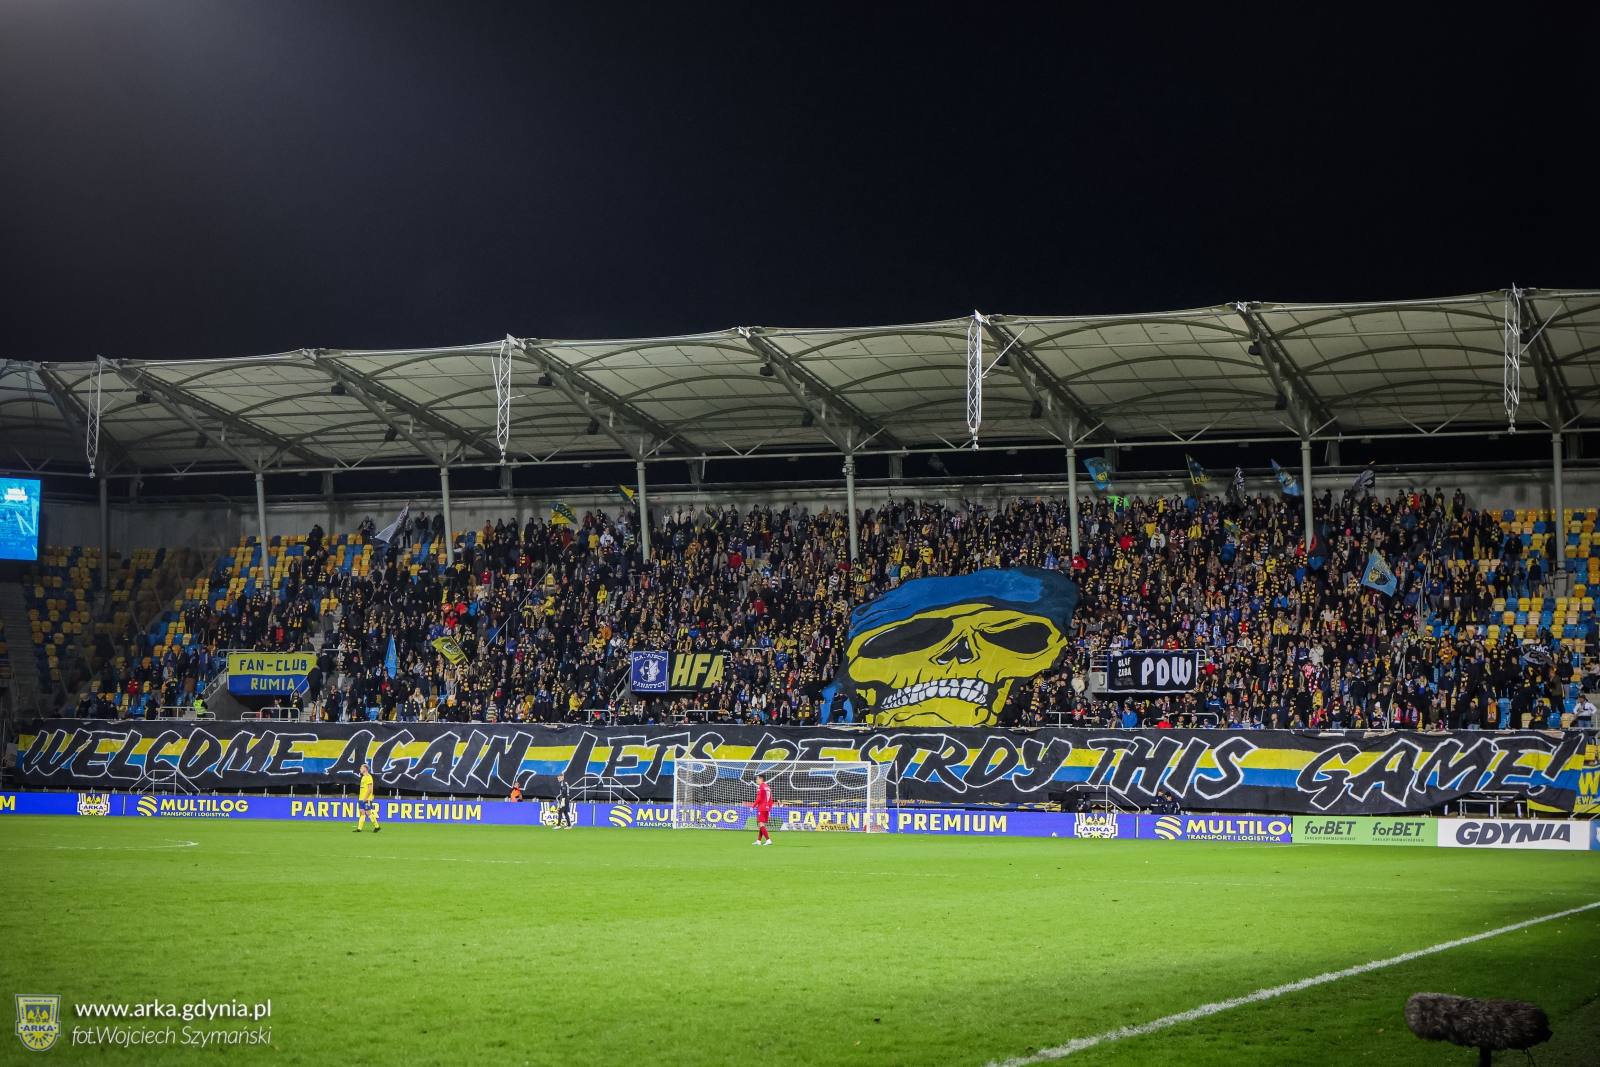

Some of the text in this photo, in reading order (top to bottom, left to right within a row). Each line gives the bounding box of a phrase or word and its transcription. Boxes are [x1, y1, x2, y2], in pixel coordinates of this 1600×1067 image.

[240, 659, 307, 671] FAN-CLUB
[671, 653, 725, 689] HFA
[1141, 657, 1192, 686] PDW
[251, 678, 295, 690] RUMIA
[22, 727, 318, 780] WELCOME
[739, 732, 1072, 793] DESTROY
[1087, 736, 1259, 799] THIS
[1295, 733, 1585, 811] GAME!
[160, 798, 249, 812] MULTILOG
[387, 802, 482, 821] PREMIUM
[636, 808, 739, 823] MULTILOG
[898, 812, 1007, 833] PREMIUM
[1186, 819, 1292, 836] MULTILO
[1304, 820, 1357, 835] forBET
[1372, 821, 1426, 837] forBET
[1455, 821, 1571, 845] GDYNIA
